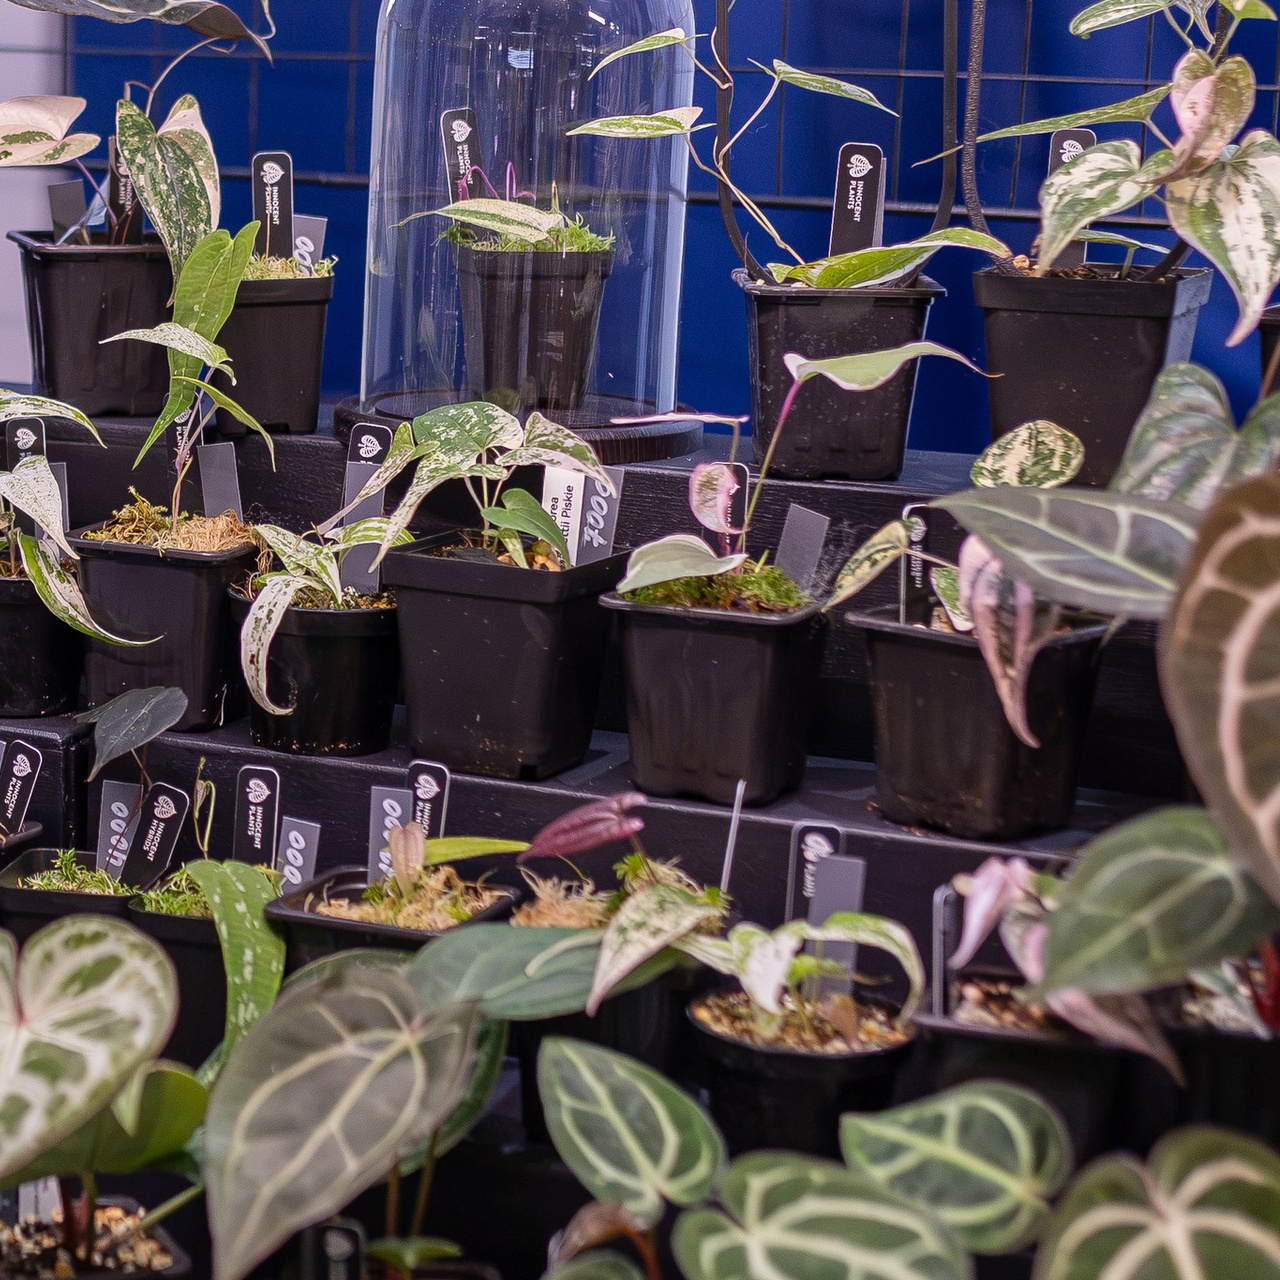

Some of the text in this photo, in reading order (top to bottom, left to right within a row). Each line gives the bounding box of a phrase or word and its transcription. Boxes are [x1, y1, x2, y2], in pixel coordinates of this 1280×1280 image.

[457, 145, 465, 174] PLANTS
[847, 180, 857, 210] PLANTS
[853, 181, 864, 222] INNOCENT
[561, 485, 574, 518] Piskie
[4, 777, 17, 804] PLANTS
[6, 780, 22, 818] INNOCENT
[106, 801, 129, 867] 4000
[143, 819, 159, 851] HYBRIDS
[247, 806, 256, 836] PLANTS
[253, 806, 264, 849] INNOCENT
[147, 822, 166, 862] INNOCENT
